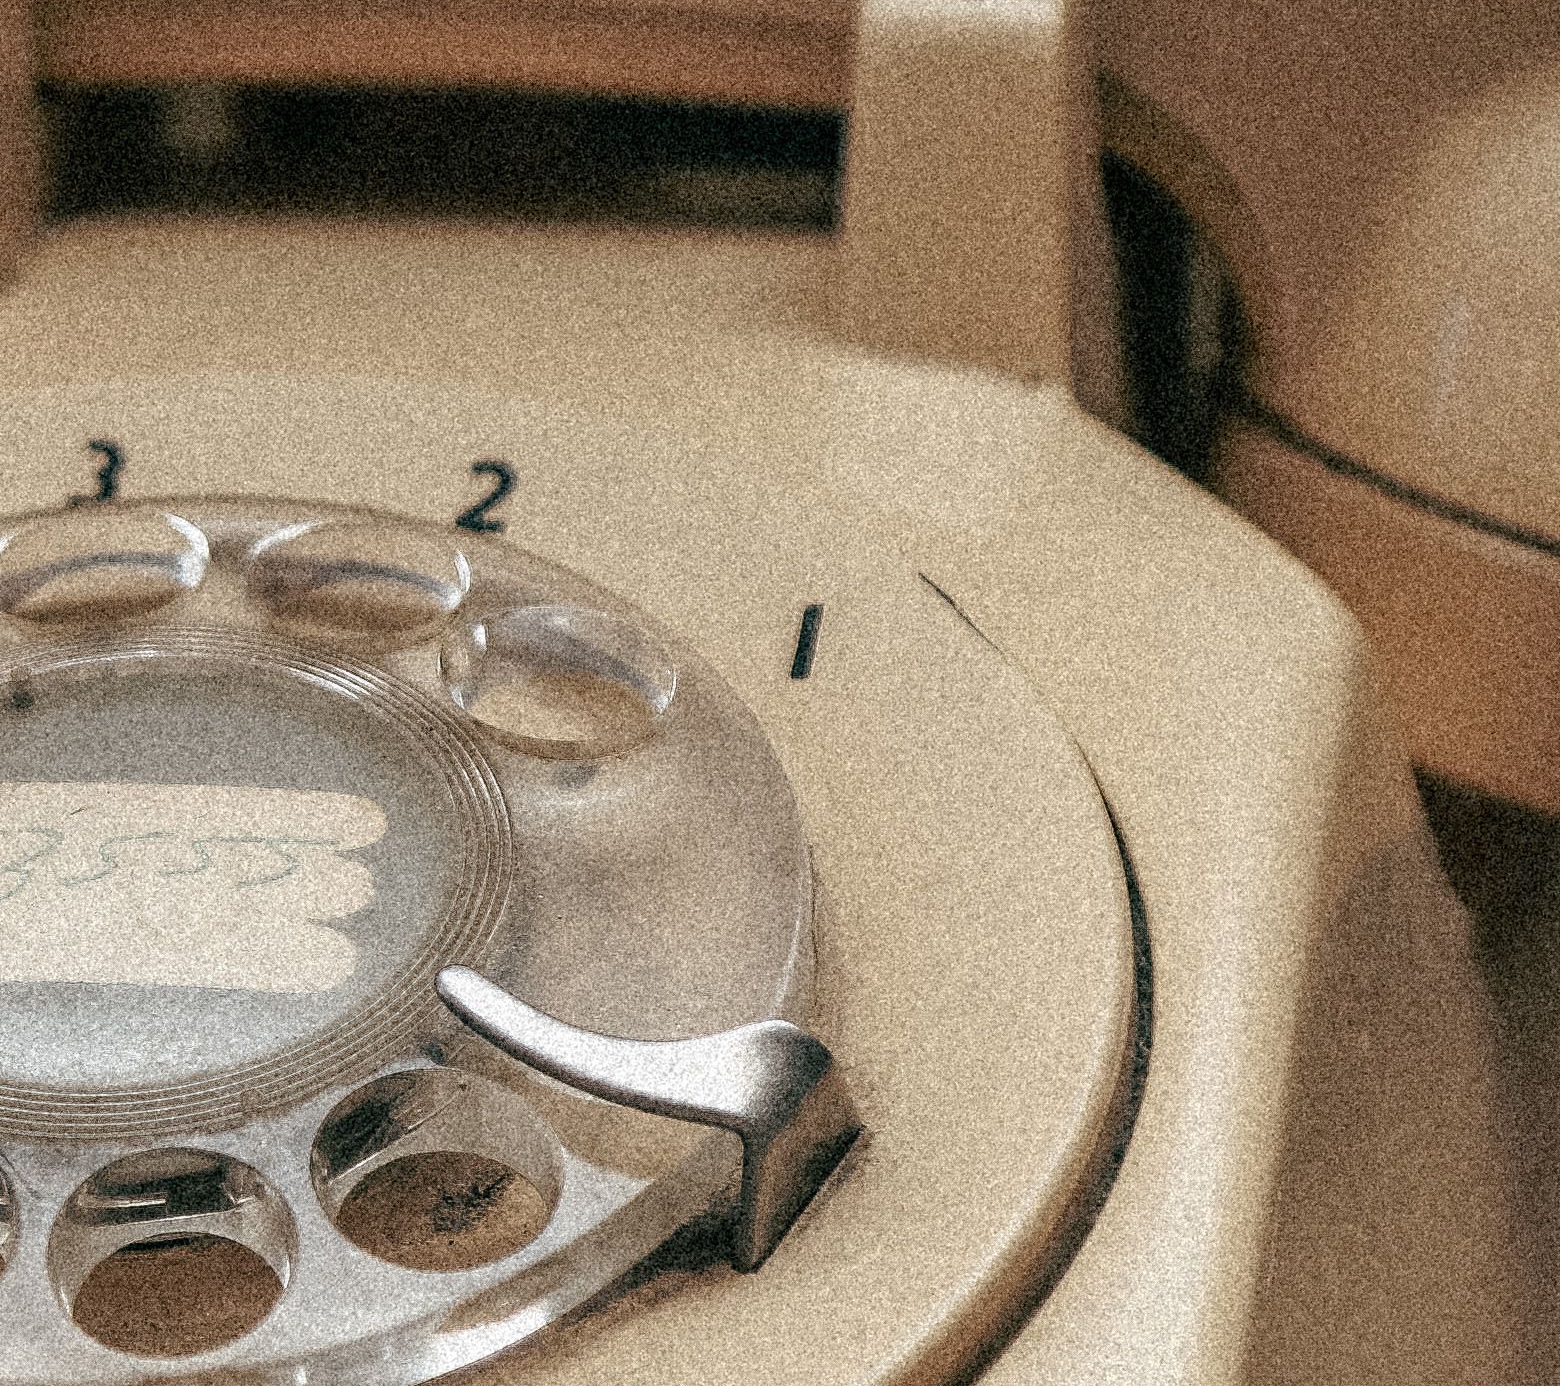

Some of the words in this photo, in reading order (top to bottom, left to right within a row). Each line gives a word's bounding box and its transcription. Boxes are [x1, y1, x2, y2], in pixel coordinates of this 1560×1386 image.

[67, 441, 124, 507] 3
[454, 462, 515, 536] 2
[789, 605, 822, 680] 1
